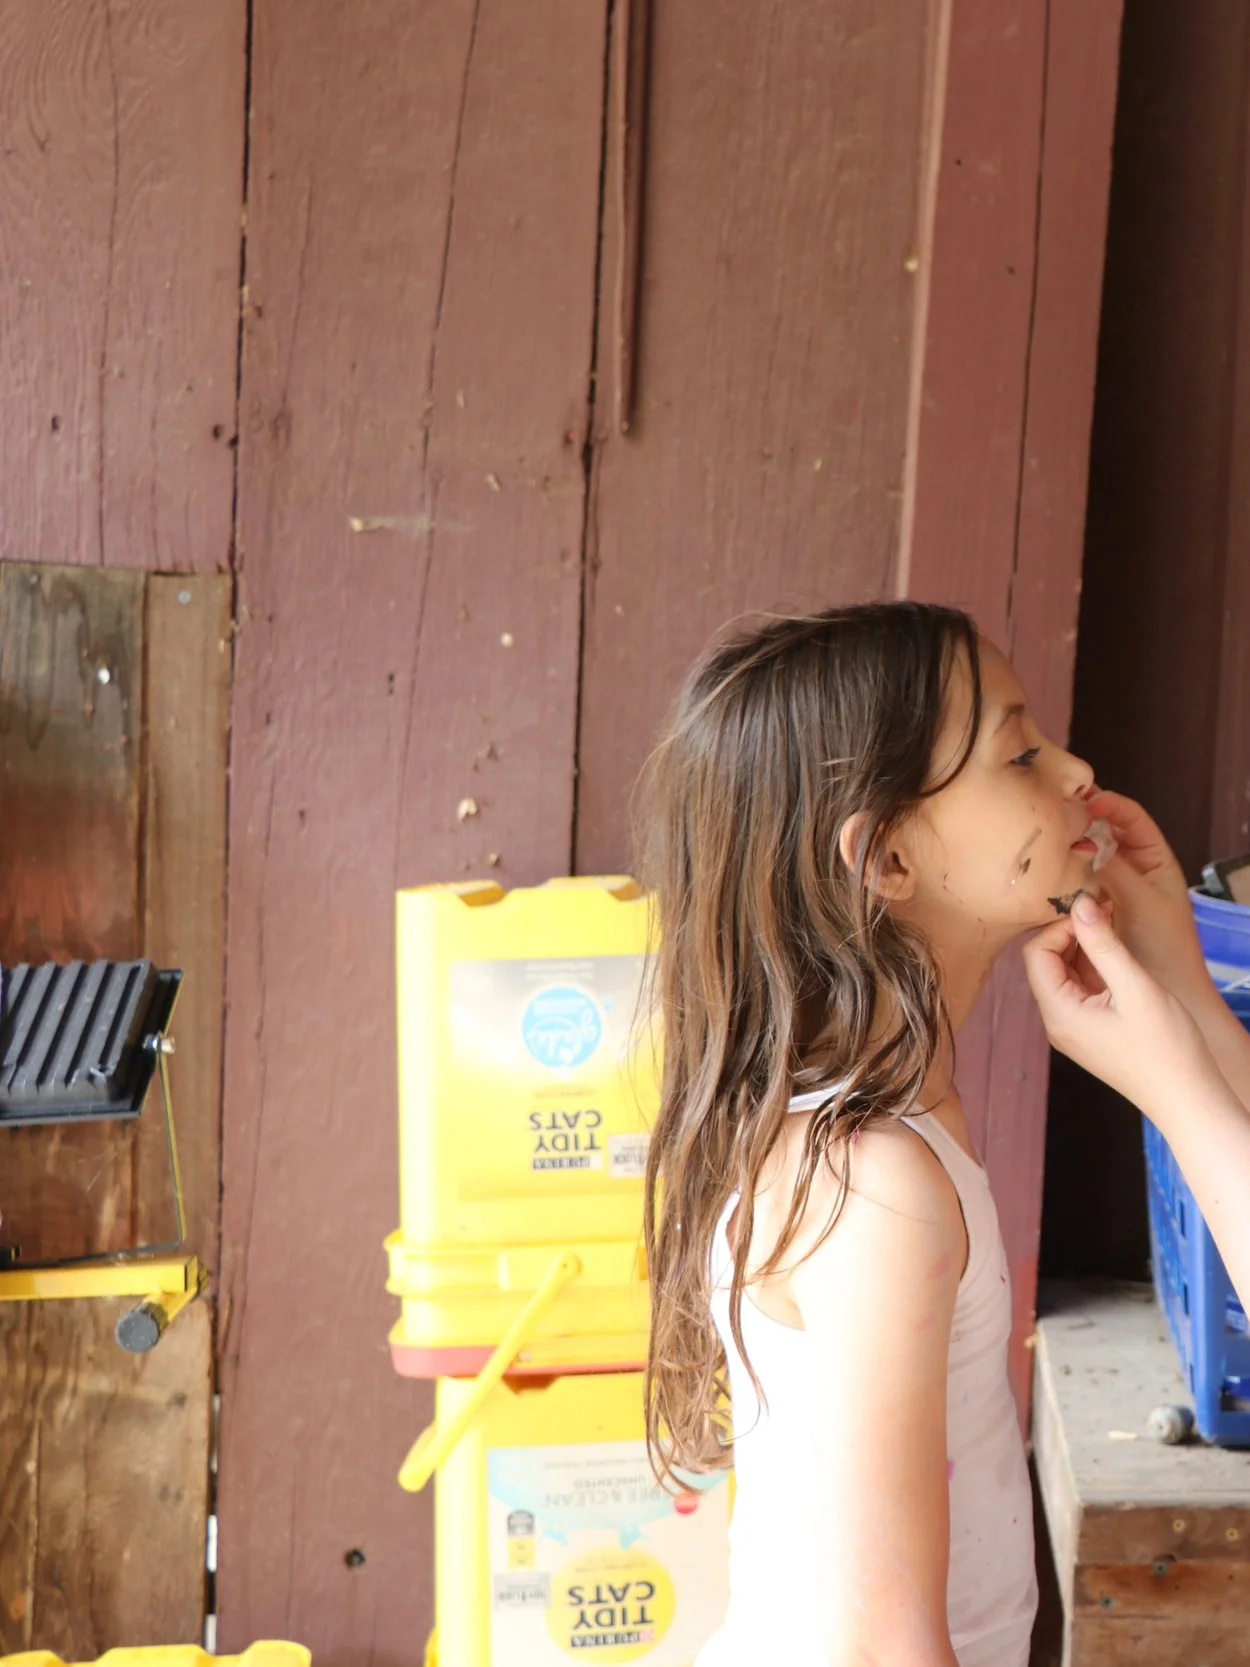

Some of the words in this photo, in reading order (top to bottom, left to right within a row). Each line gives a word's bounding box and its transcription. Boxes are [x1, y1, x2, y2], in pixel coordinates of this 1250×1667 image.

[530, 1110, 602, 1131] CATS
[534, 1133, 601, 1153] TIDY
[533, 1157, 590, 1170] PURINA
[567, 1580, 656, 1606] CATS
[572, 1605, 654, 1630] TIDY
[571, 1632, 640, 1648] PURINA
